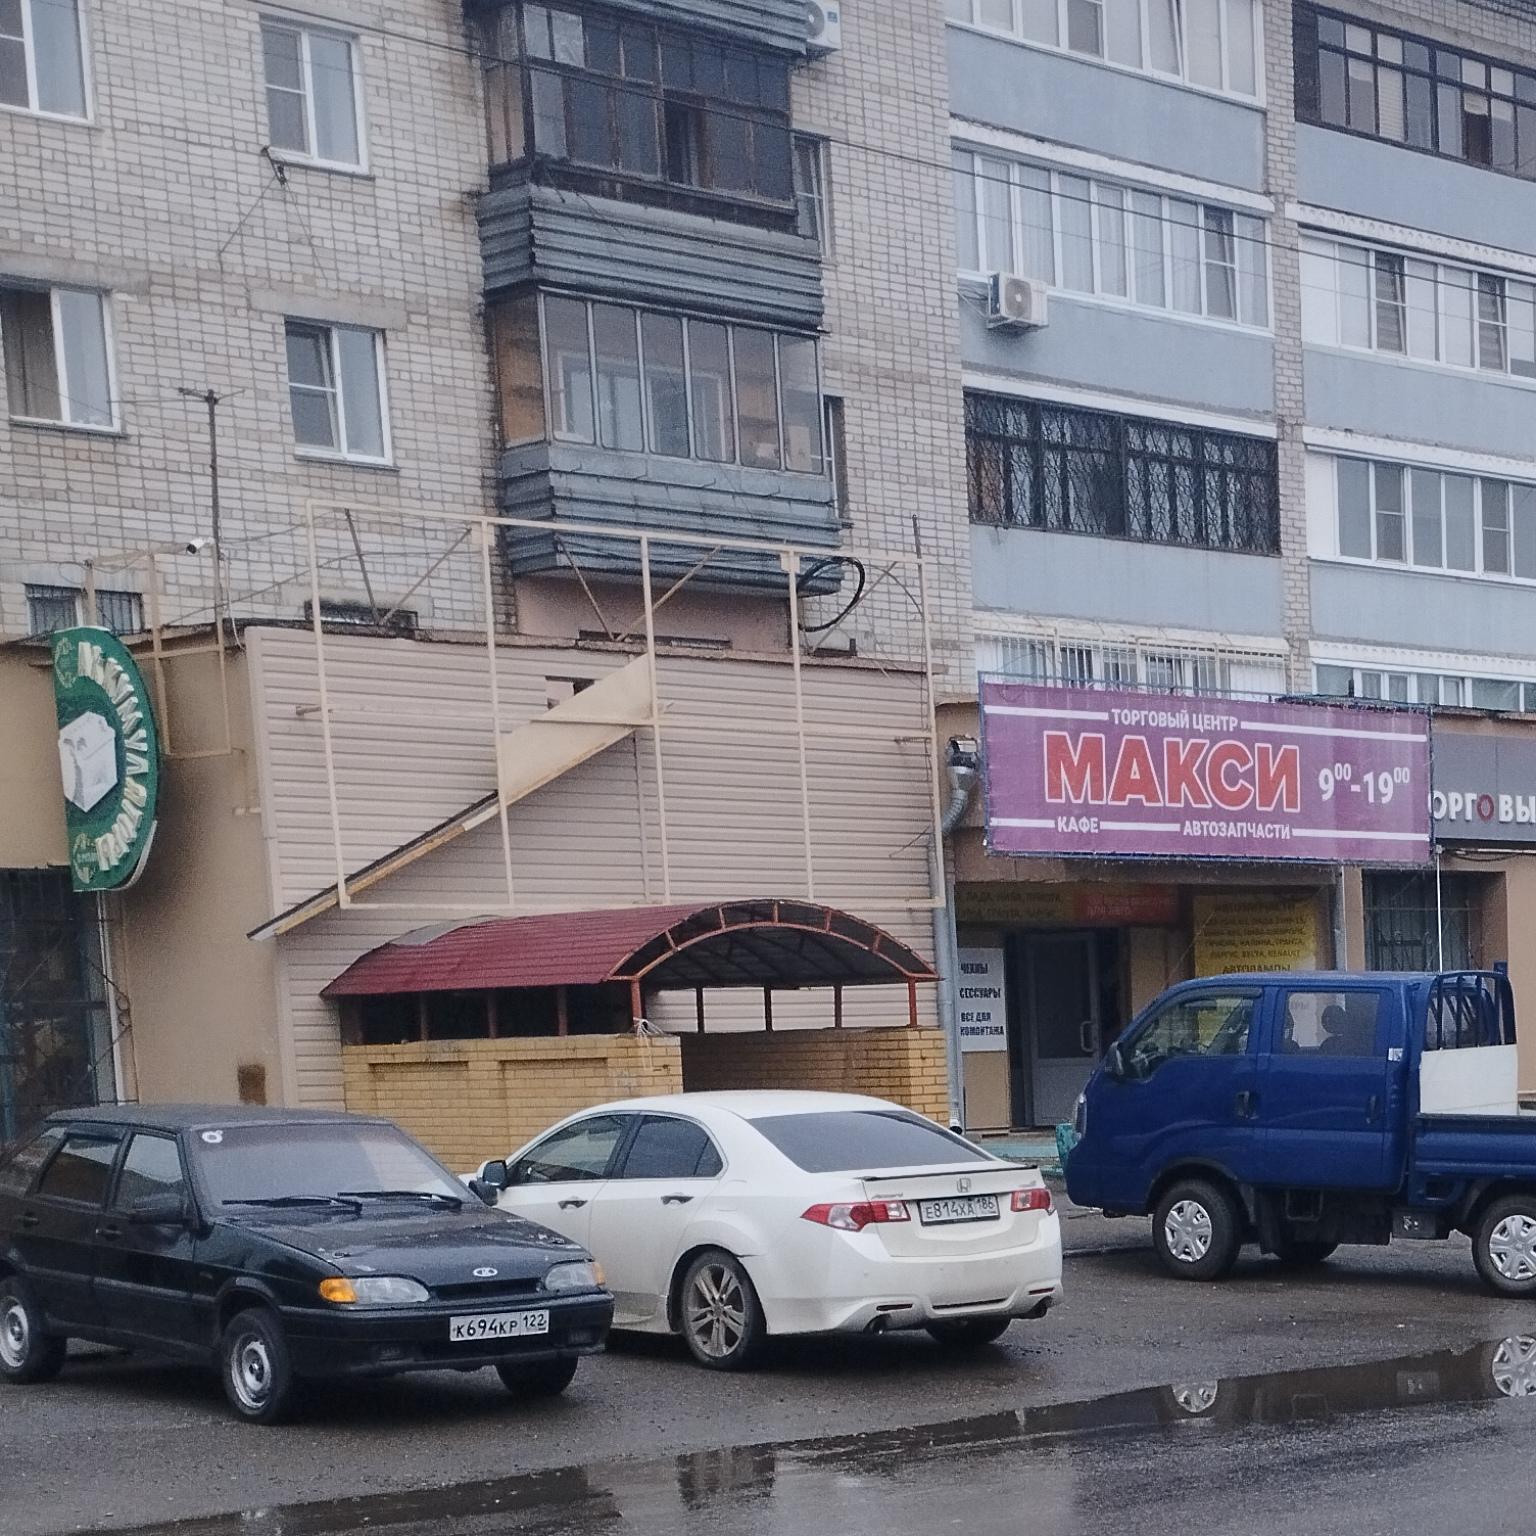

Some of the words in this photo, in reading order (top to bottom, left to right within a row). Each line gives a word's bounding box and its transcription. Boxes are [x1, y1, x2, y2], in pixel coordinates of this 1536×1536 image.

[1112, 708, 1189, 730] ТОРГОВЫЙ
[1193, 713, 1238, 733] ЦЕНТР
[1043, 731, 1300, 813] МАКСИ
[1057, 815, 1099, 835] КАФЕ
[1183, 820, 1291, 841] АВТОЗАПЧАСТИ
[960, 987, 1001, 999] СЕССУАРЫ
[456, 1318, 518, 1338] К694КР
[523, 1313, 547, 1328] 122
